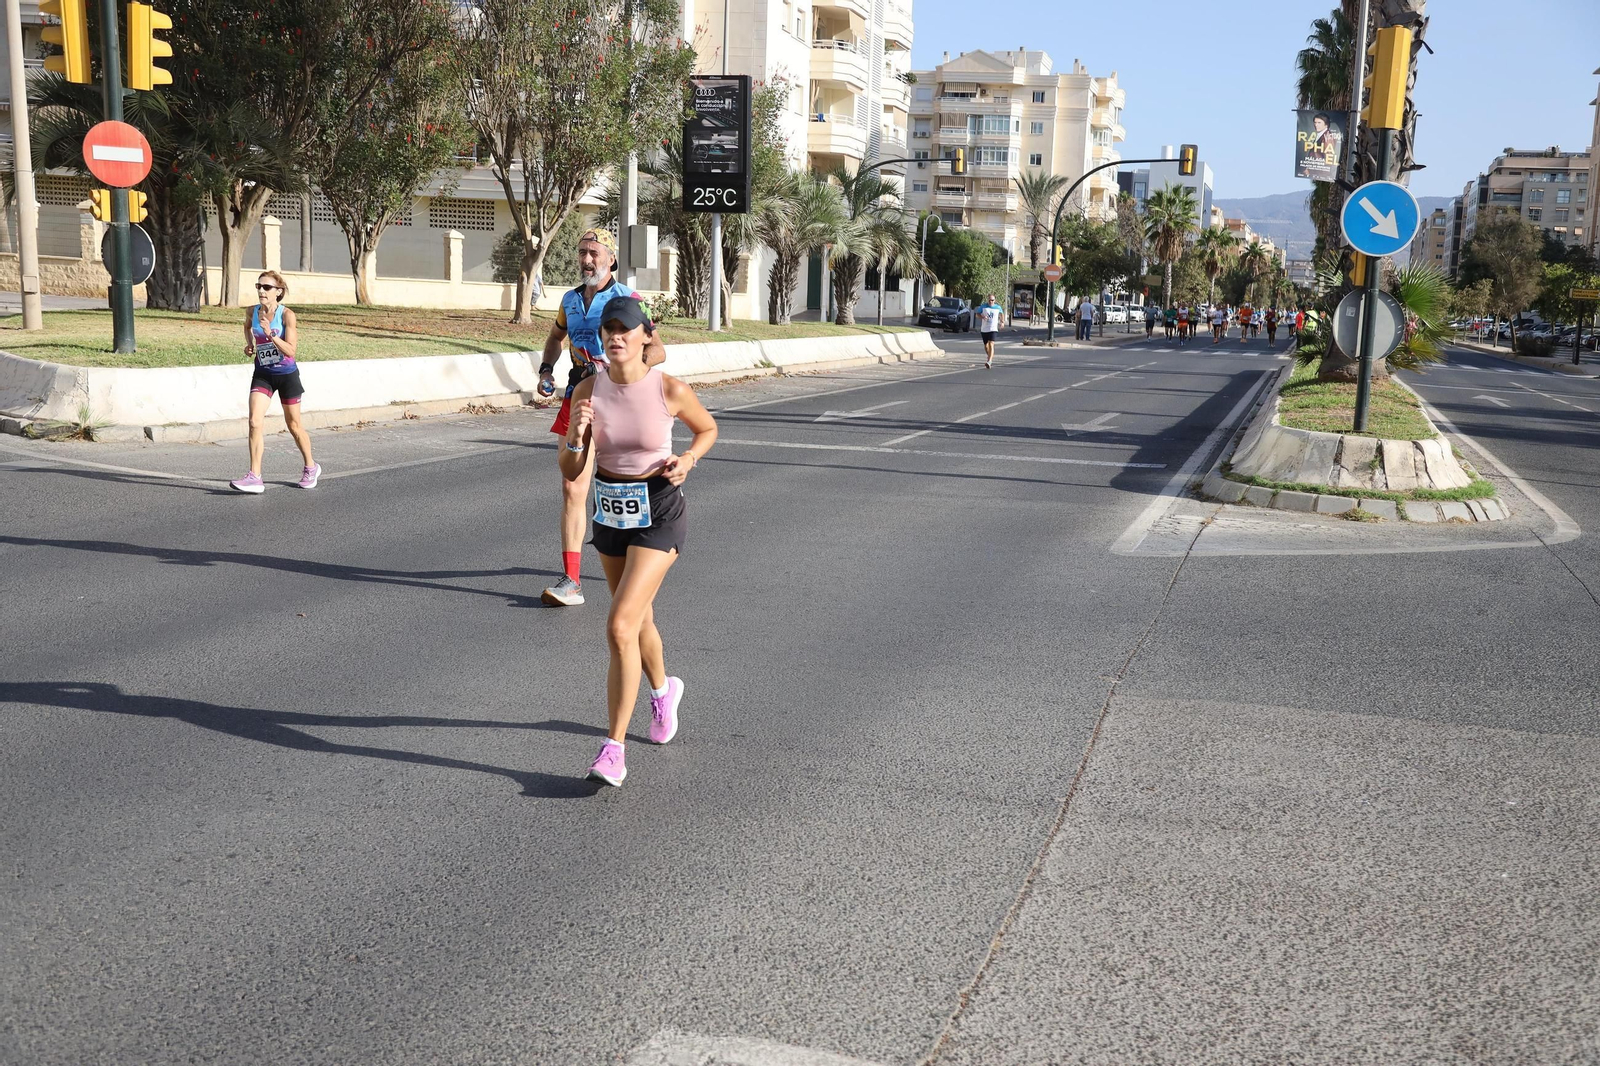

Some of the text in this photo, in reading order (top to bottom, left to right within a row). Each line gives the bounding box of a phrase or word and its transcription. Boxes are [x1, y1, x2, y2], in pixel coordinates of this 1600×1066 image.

[1298, 131, 1317, 142] RA
[1304, 142, 1335, 154] PHA
[1325, 154, 1340, 165] EL
[693, 188, 736, 206] 25°C
[260, 350, 278, 359] 344
[601, 497, 639, 515] 669
